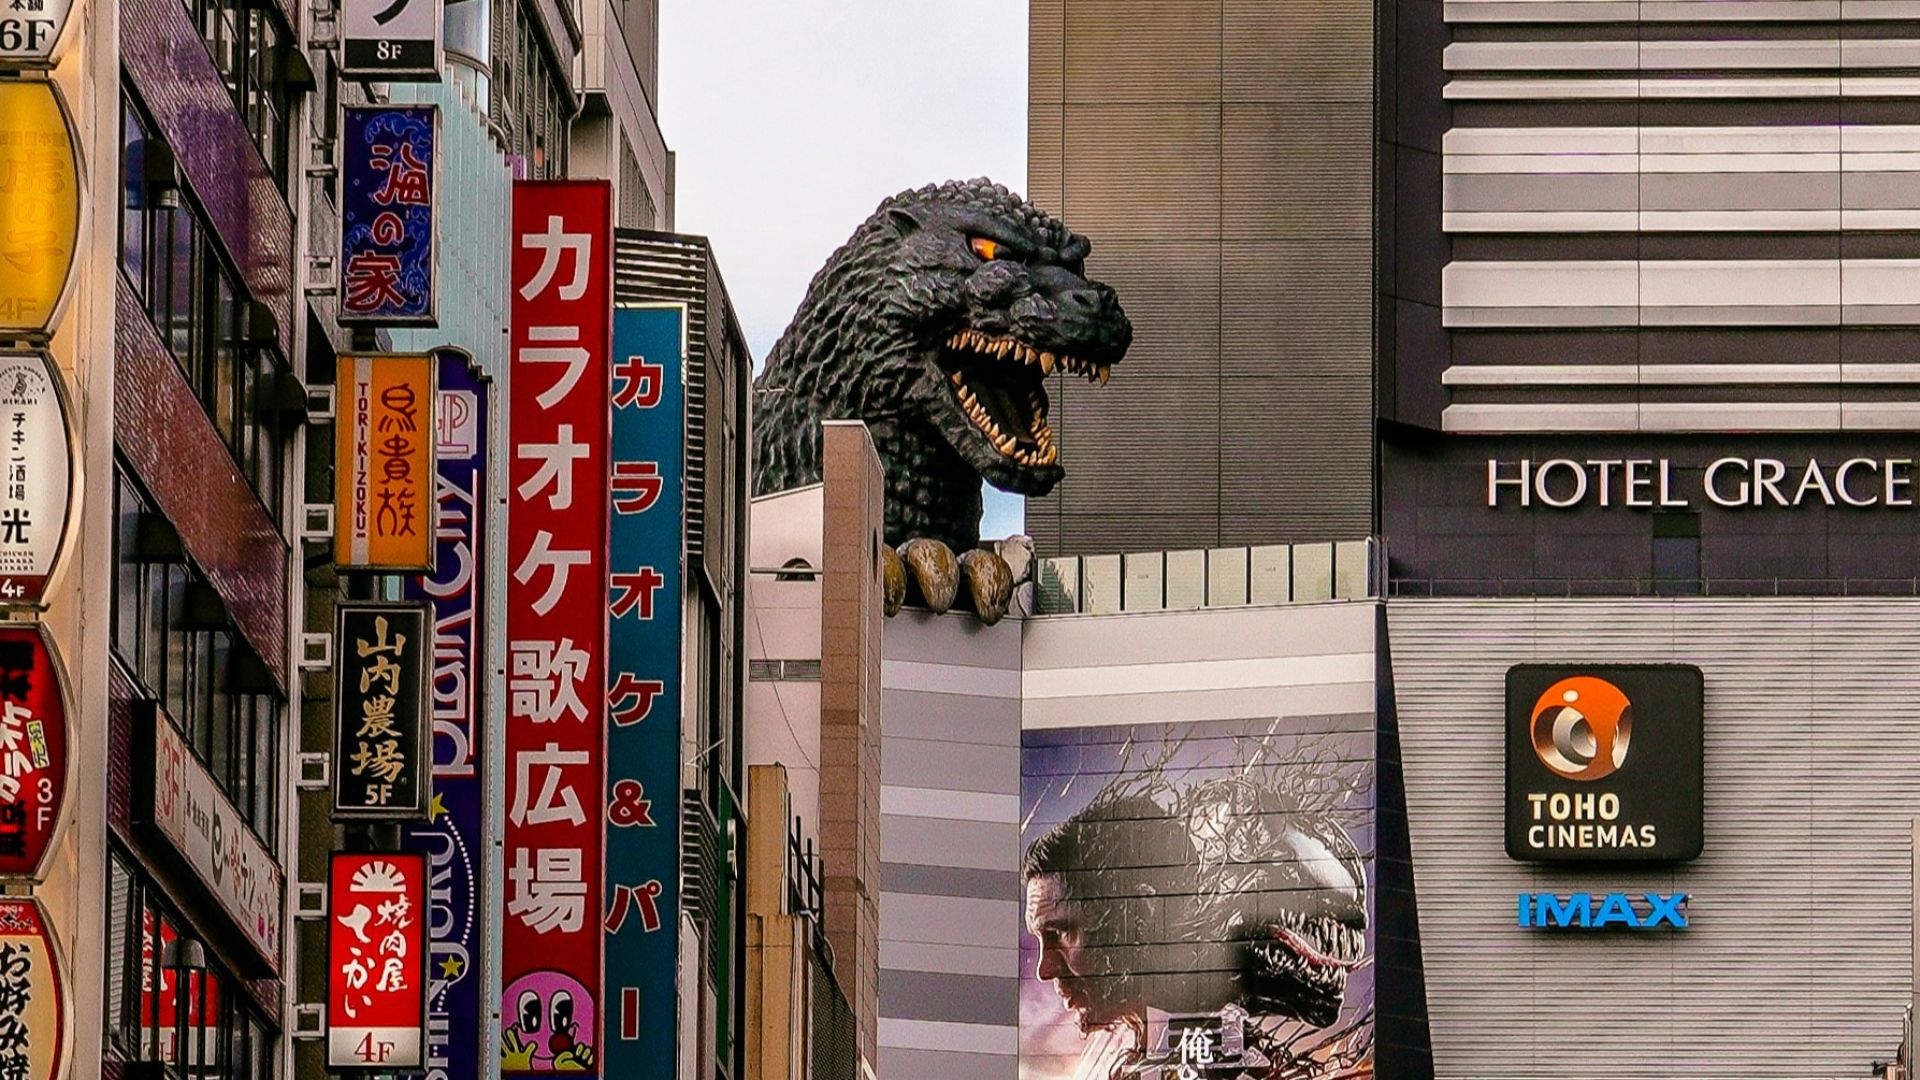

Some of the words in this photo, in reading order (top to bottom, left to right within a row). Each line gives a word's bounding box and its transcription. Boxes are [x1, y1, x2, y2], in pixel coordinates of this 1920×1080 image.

[0, 18, 55, 51] 6F
[376, 40, 402, 60] 8F
[342, 142, 430, 312] 海の家
[356, 382, 369, 530] TORIKIZOKU
[377, 383, 418, 537] 鳥貴族
[1486, 458, 1689, 508] HOTEL
[1703, 457, 1913, 508] GRACE
[1, 507, 31, 544] 光
[1, 578, 26, 598] 4F
[508, 215, 592, 935] カラオケ歌広場
[350, 615, 406, 783] 山内農場
[36, 777, 54, 831] 3F
[162, 735, 182, 823] 3F
[364, 784, 393, 805] 5F
[1528, 793, 1620, 821] TOHO
[1527, 824, 1657, 848] CINEMAS
[1517, 892, 1688, 929] IMAX
[336, 903, 376, 1019] さかい
[373, 893, 414, 992] 焼肉屋
[353, 1031, 396, 1064] 4F
